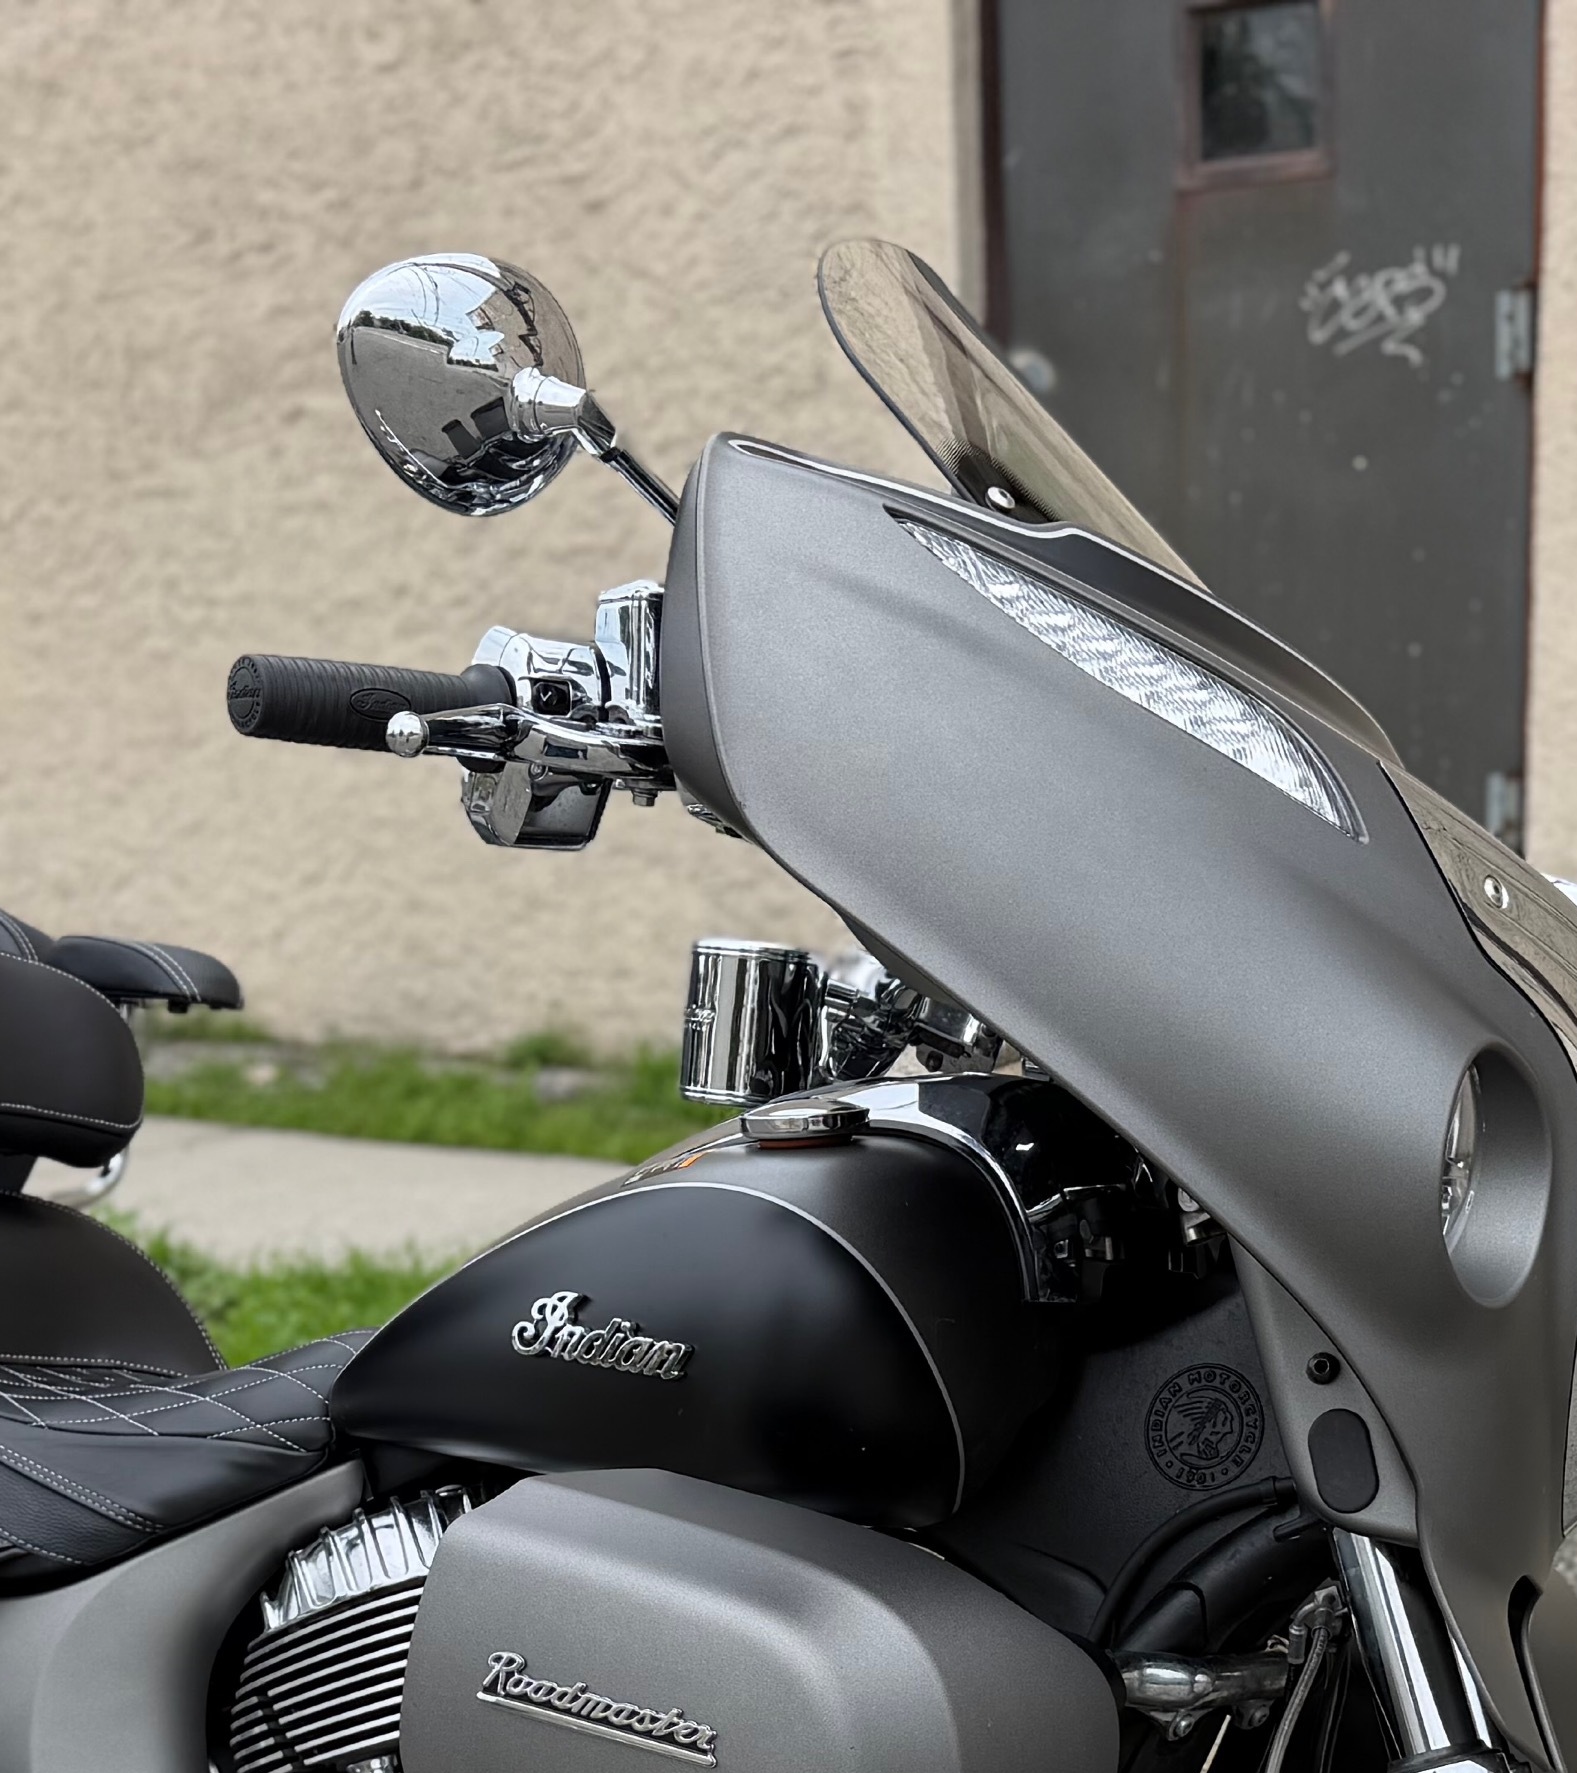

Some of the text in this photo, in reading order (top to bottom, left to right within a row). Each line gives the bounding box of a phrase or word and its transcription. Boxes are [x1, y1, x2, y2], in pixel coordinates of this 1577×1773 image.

[511, 1290, 695, 1380] Indian
[1150, 1369, 1259, 1468] INDIAN MOTORCYCLE
[482, 1650, 717, 1750] Roadmaster
